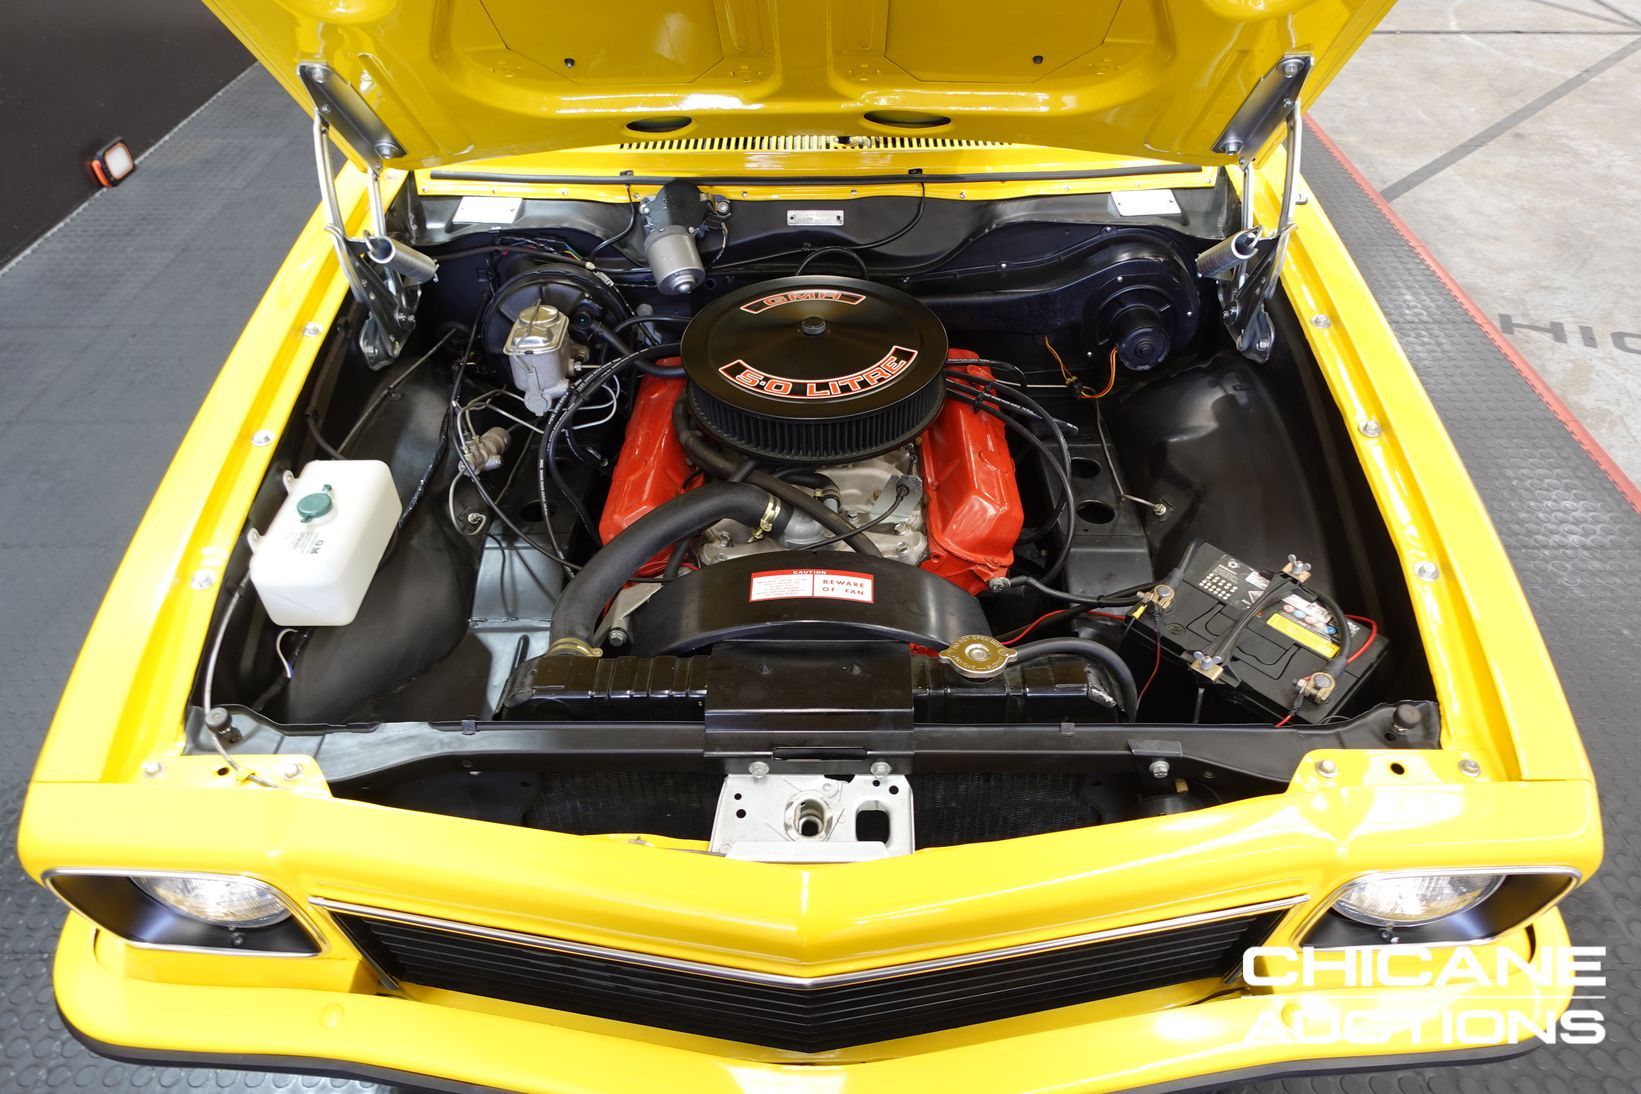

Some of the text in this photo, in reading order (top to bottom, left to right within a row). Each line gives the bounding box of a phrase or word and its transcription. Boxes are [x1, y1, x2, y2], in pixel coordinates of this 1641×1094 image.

[763, 291, 841, 306] GMH
[806, 356, 906, 397] LITRE
[823, 579, 865, 588] BEWARE
